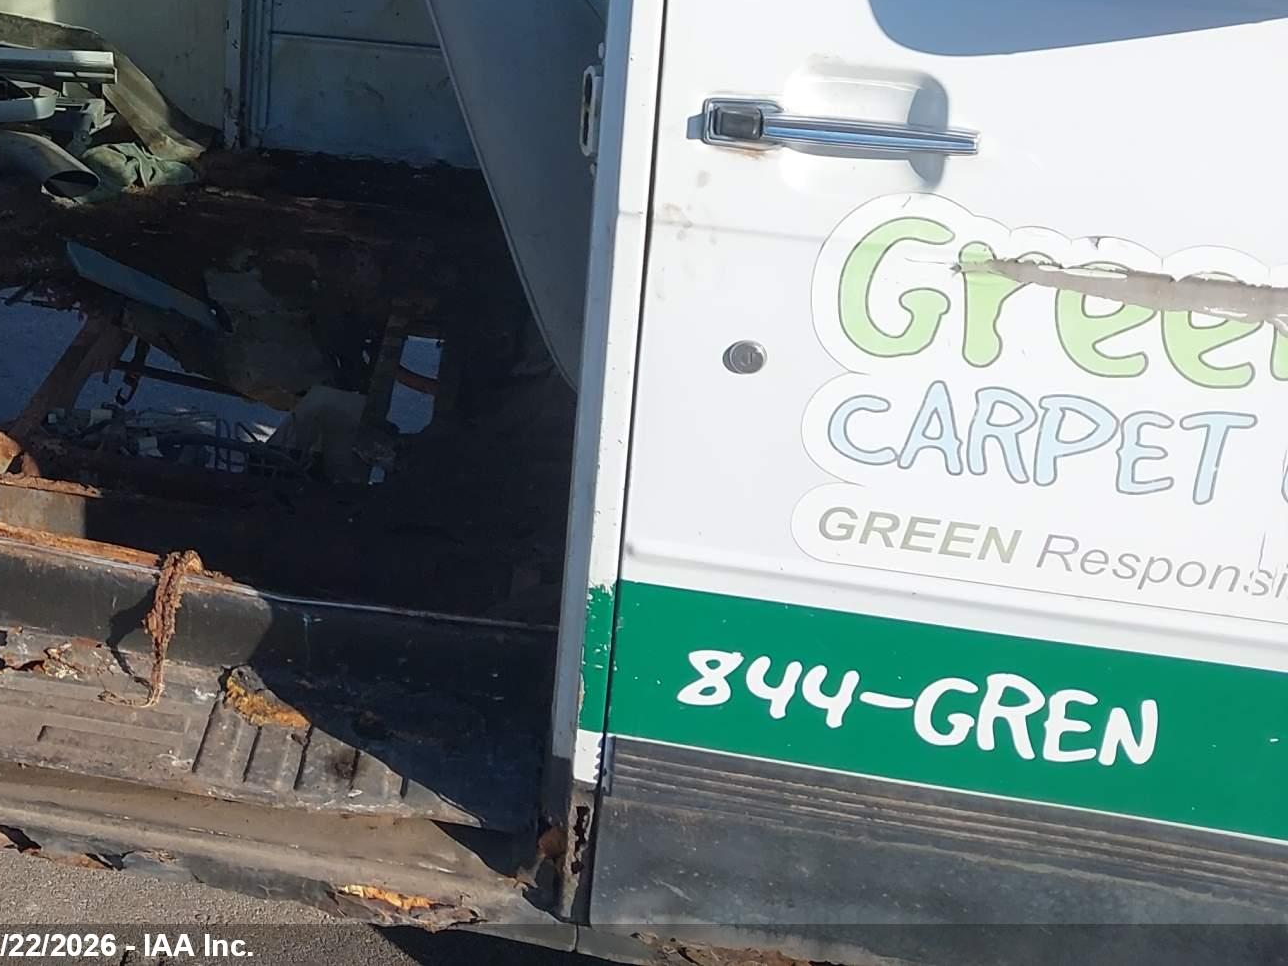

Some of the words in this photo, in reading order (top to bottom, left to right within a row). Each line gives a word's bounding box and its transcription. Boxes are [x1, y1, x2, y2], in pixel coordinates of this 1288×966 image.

[828, 380, 1259, 506] CARPET
[818, 506, 1023, 564] GREEN
[676, 649, 1159, 767] 844-GREN
